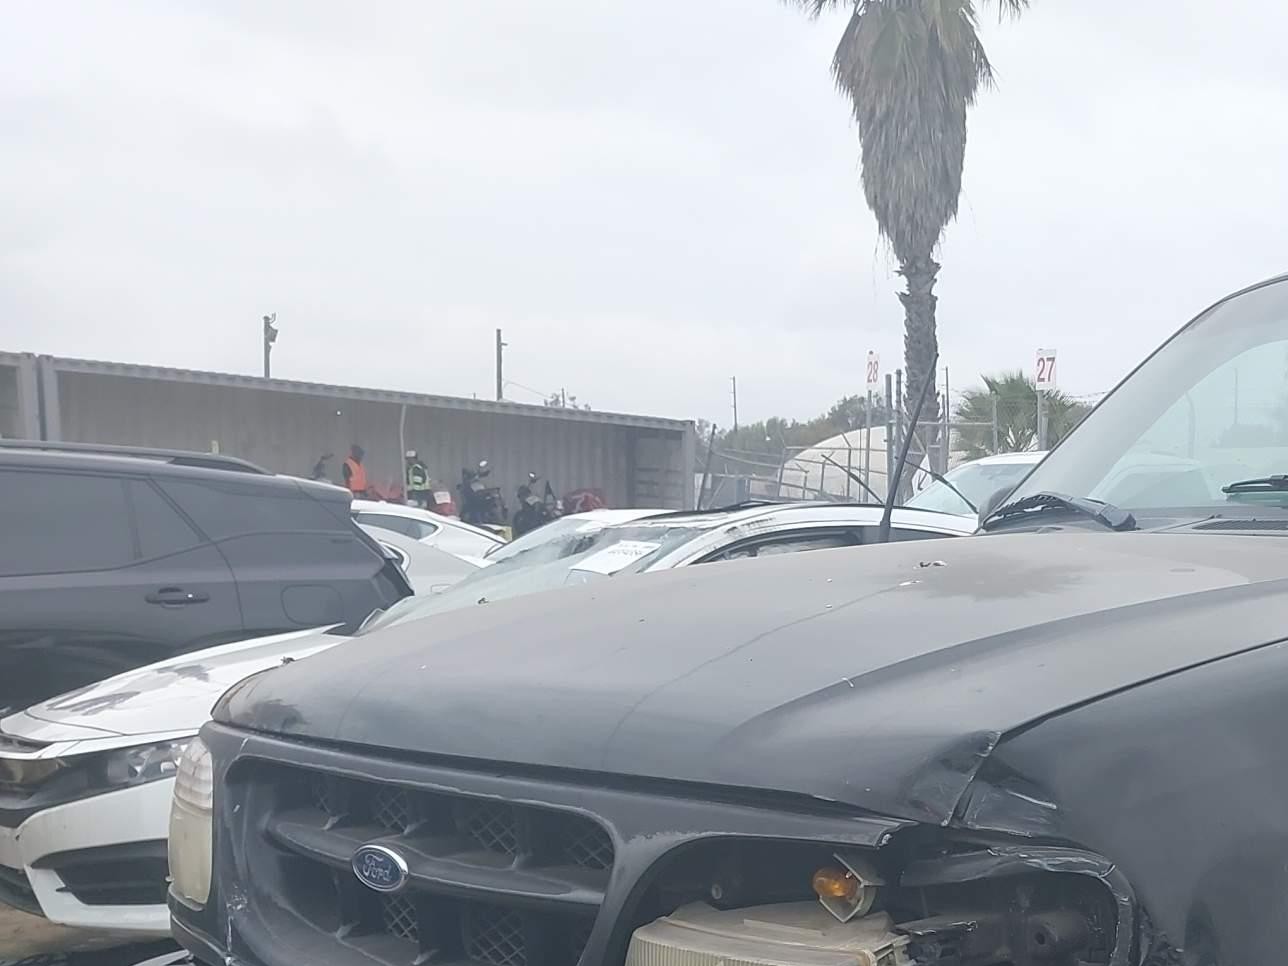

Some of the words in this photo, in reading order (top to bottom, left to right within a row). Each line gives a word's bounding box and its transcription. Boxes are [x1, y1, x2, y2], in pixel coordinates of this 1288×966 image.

[867, 361, 879, 383] 28
[1037, 357, 1056, 382] 27
[362, 853, 393, 882] Ford
